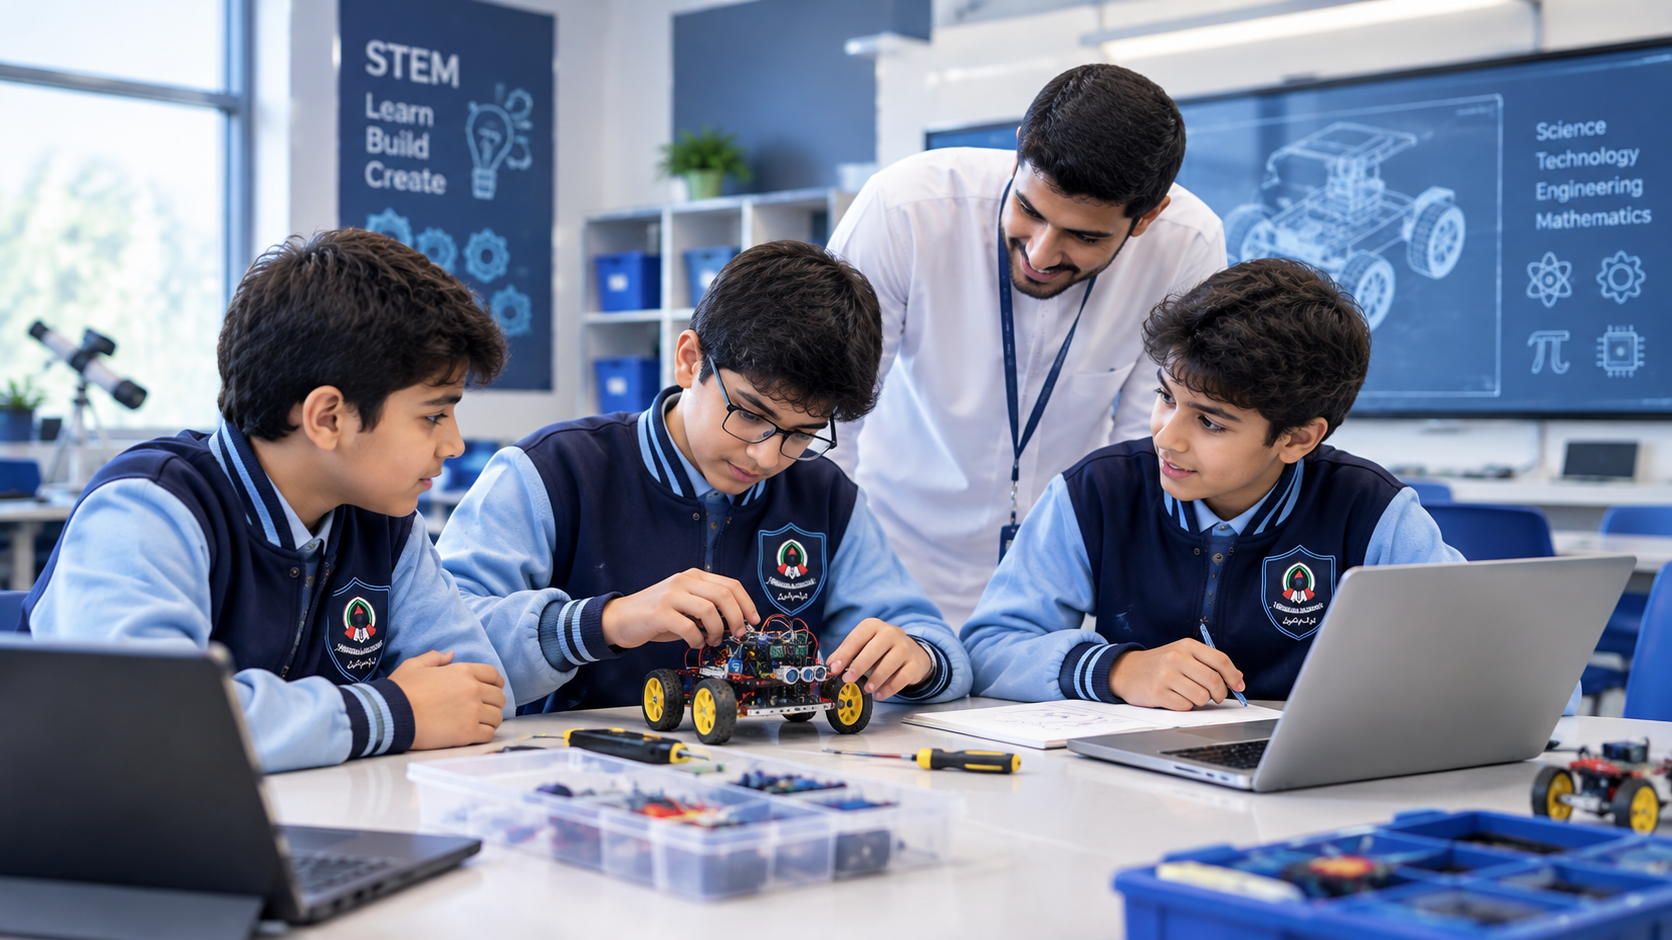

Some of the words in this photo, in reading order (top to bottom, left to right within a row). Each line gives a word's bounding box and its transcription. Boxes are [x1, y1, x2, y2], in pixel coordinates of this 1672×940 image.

[365, 40, 459, 88] STEM
[365, 93, 434, 127] Learn
[365, 126, 430, 160] Build
[1535, 120, 1607, 142] Science
[1535, 147, 1640, 170] Technology
[364, 161, 447, 195] Create
[1535, 176, 1644, 203] Engineering
[1535, 206, 1652, 230] Mathematics
